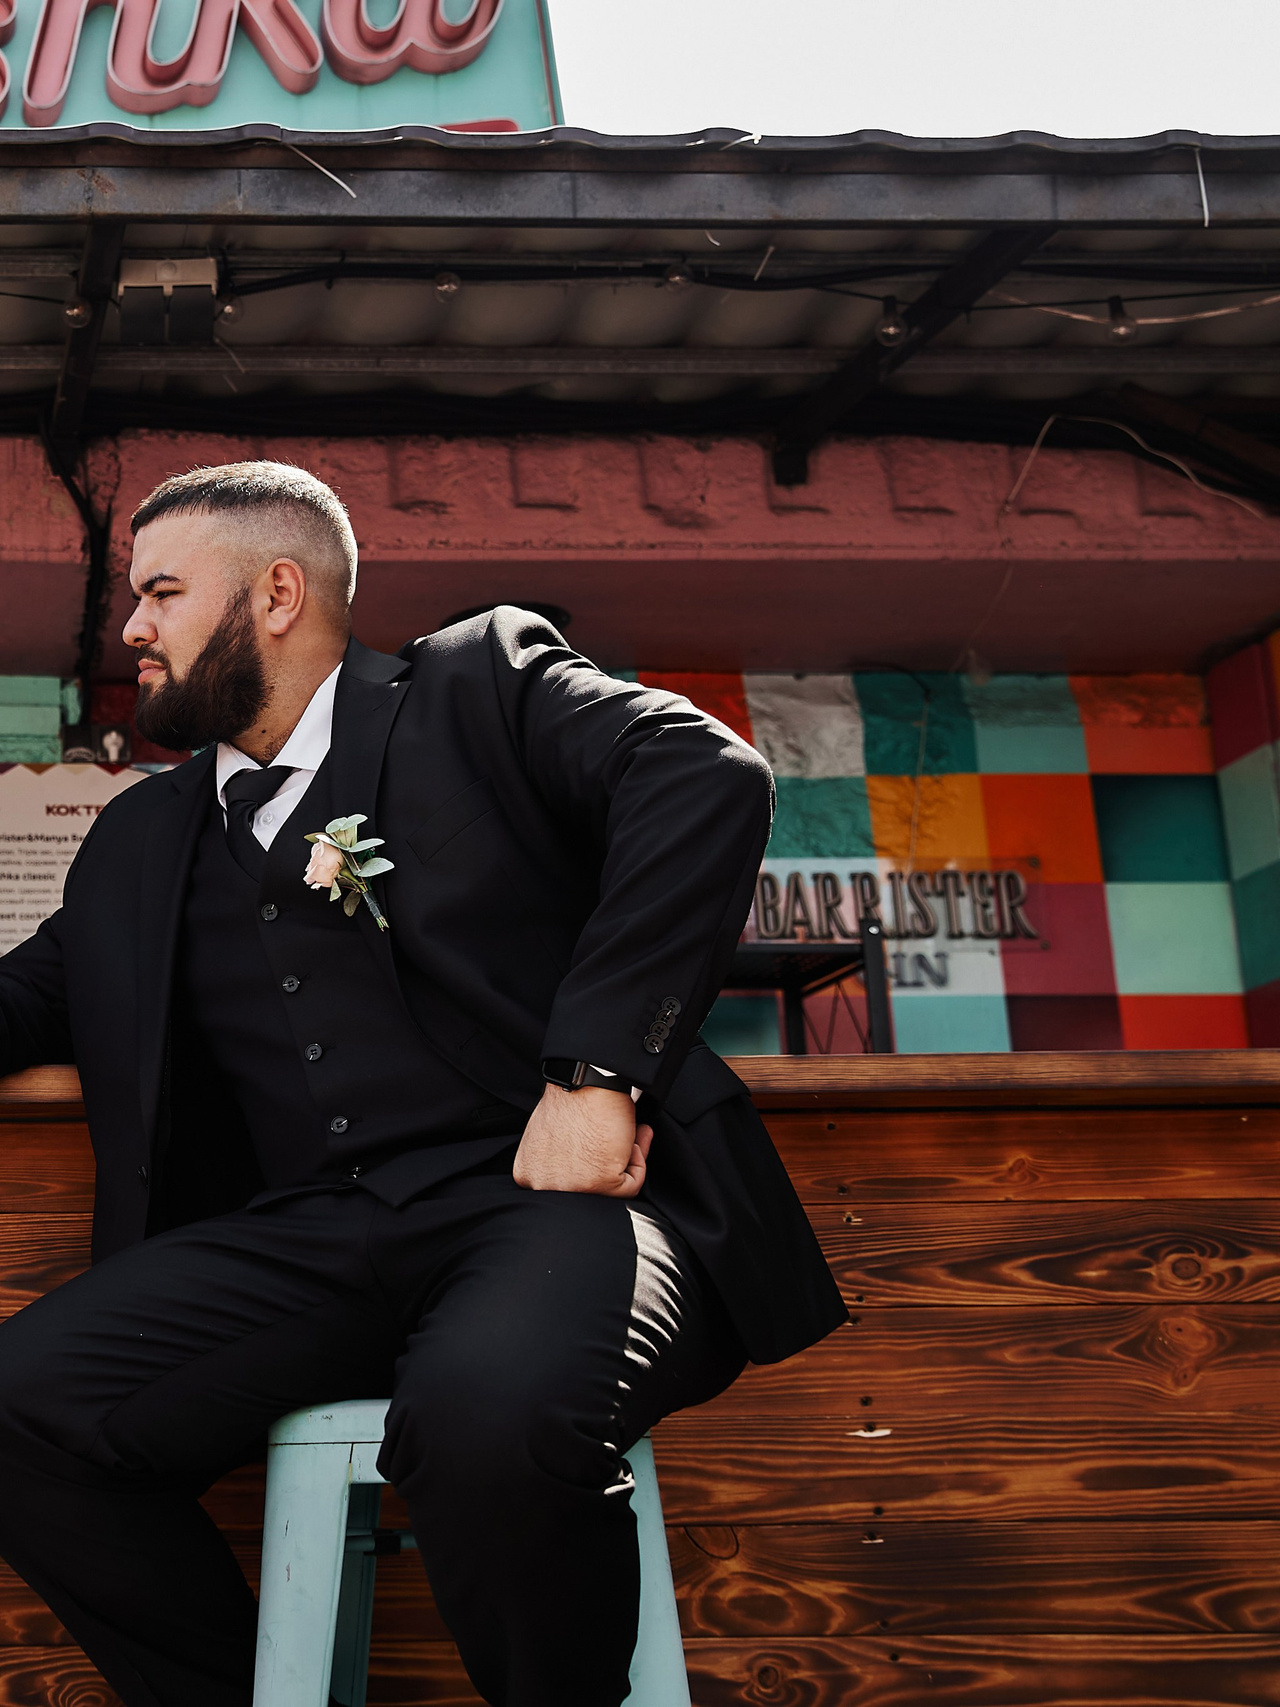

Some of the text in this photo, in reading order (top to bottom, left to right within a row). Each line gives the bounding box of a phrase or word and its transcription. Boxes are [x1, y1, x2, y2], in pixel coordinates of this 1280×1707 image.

[22, 872, 56, 881] classic
[755, 869, 1039, 940] BARRISTER
[880, 952, 949, 988] IN
